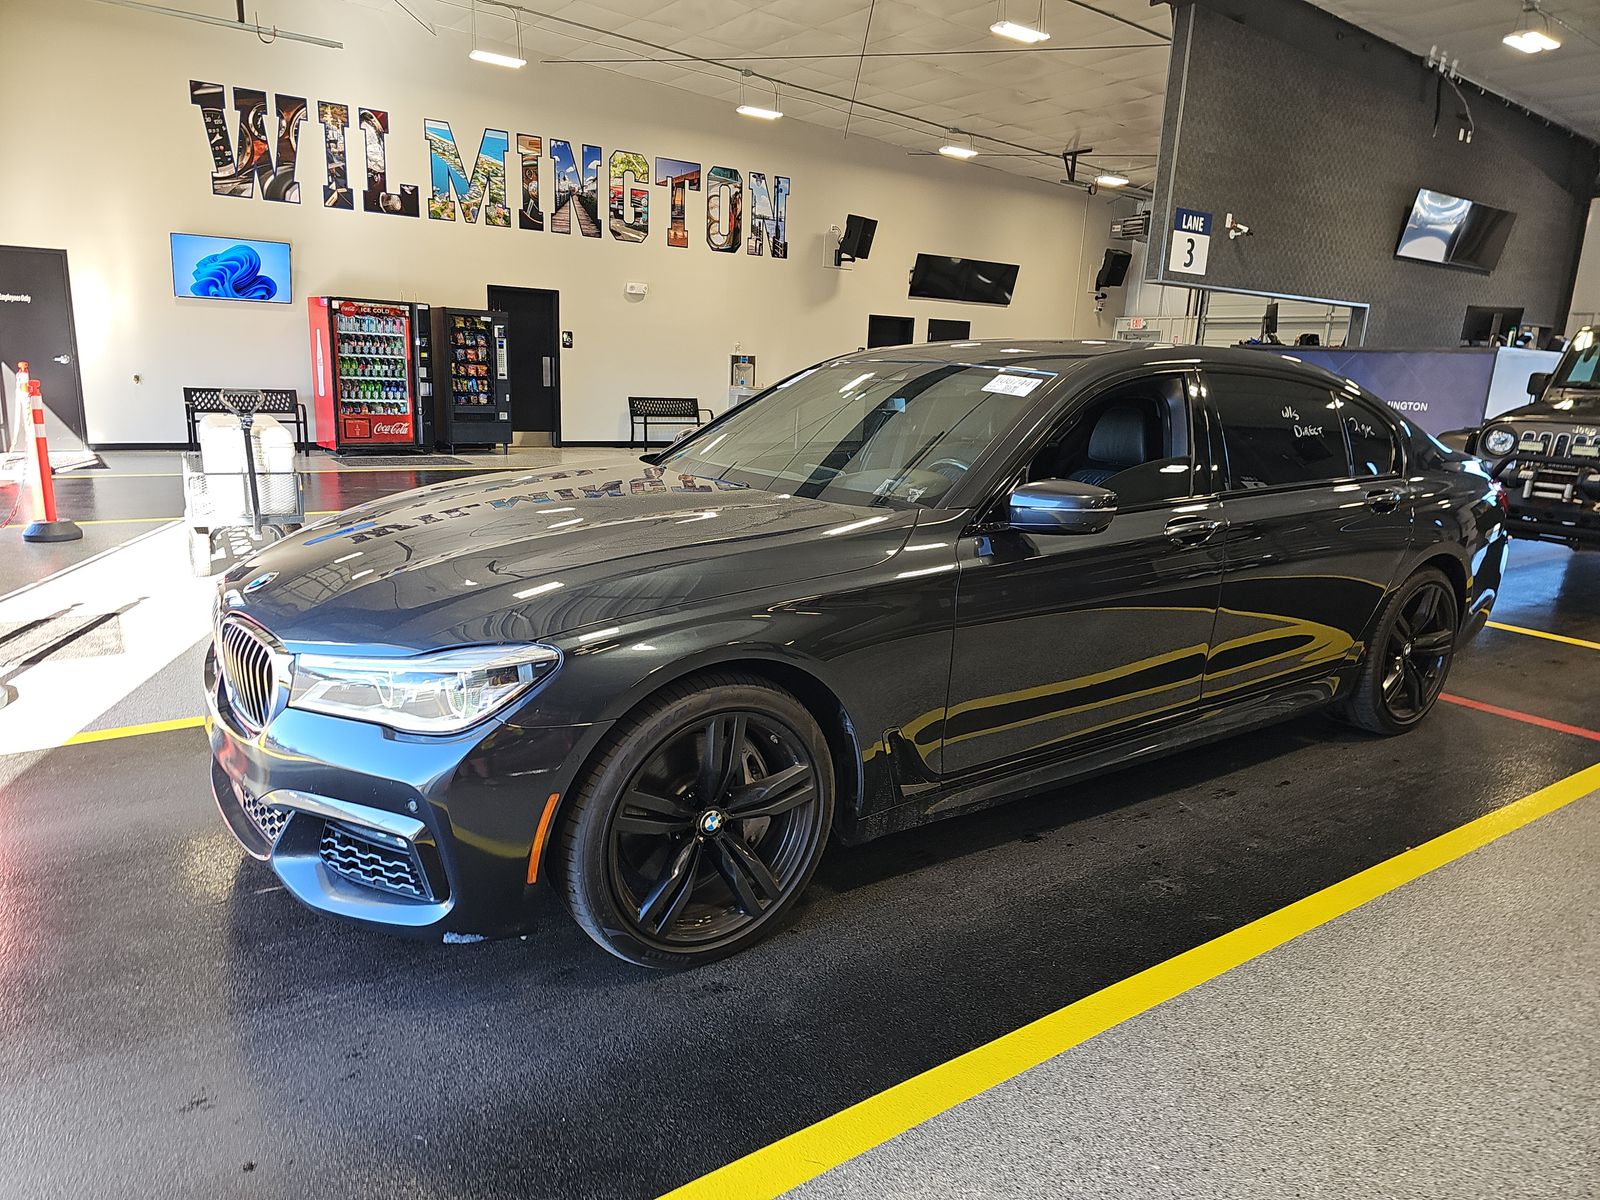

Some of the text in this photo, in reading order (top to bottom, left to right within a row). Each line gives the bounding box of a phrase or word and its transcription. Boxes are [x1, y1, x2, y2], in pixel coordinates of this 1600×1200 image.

[188, 79, 790, 260] WILMINGTON
[1182, 213, 1205, 232] LANE
[1183, 238, 1195, 268] 3
[1387, 400, 1428, 412] INGTON
[373, 422, 410, 435] Coca-Cola
